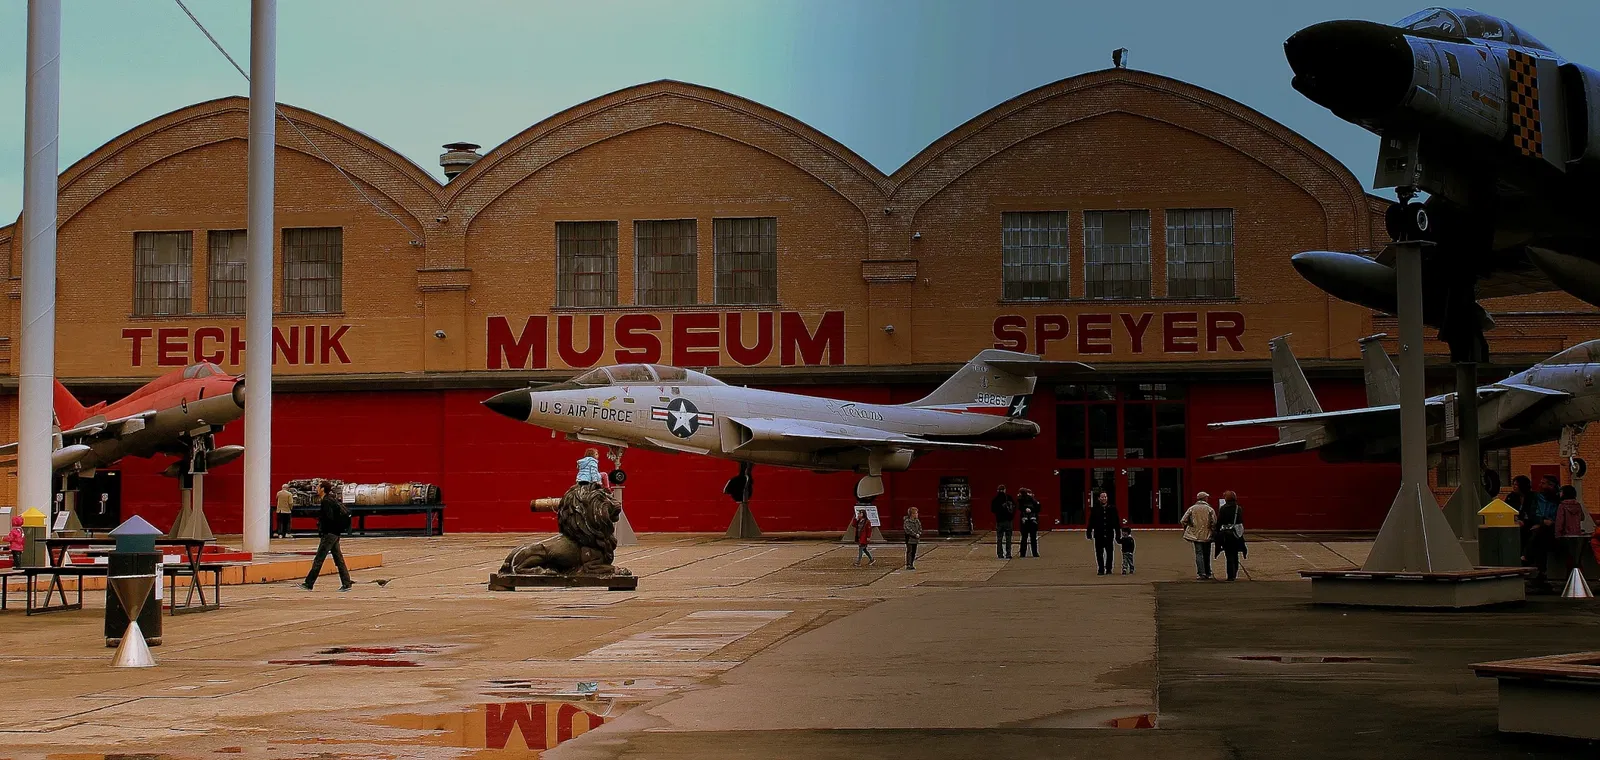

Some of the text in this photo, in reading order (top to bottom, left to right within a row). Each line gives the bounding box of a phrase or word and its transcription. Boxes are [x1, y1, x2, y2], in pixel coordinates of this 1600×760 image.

[486, 311, 846, 370] MUSEUM
[992, 311, 1247, 355] SPEYER
[567, 404, 587, 417] AIR
[592, 407, 633, 423] FORCE
[839, 403, 884, 421] Texans
